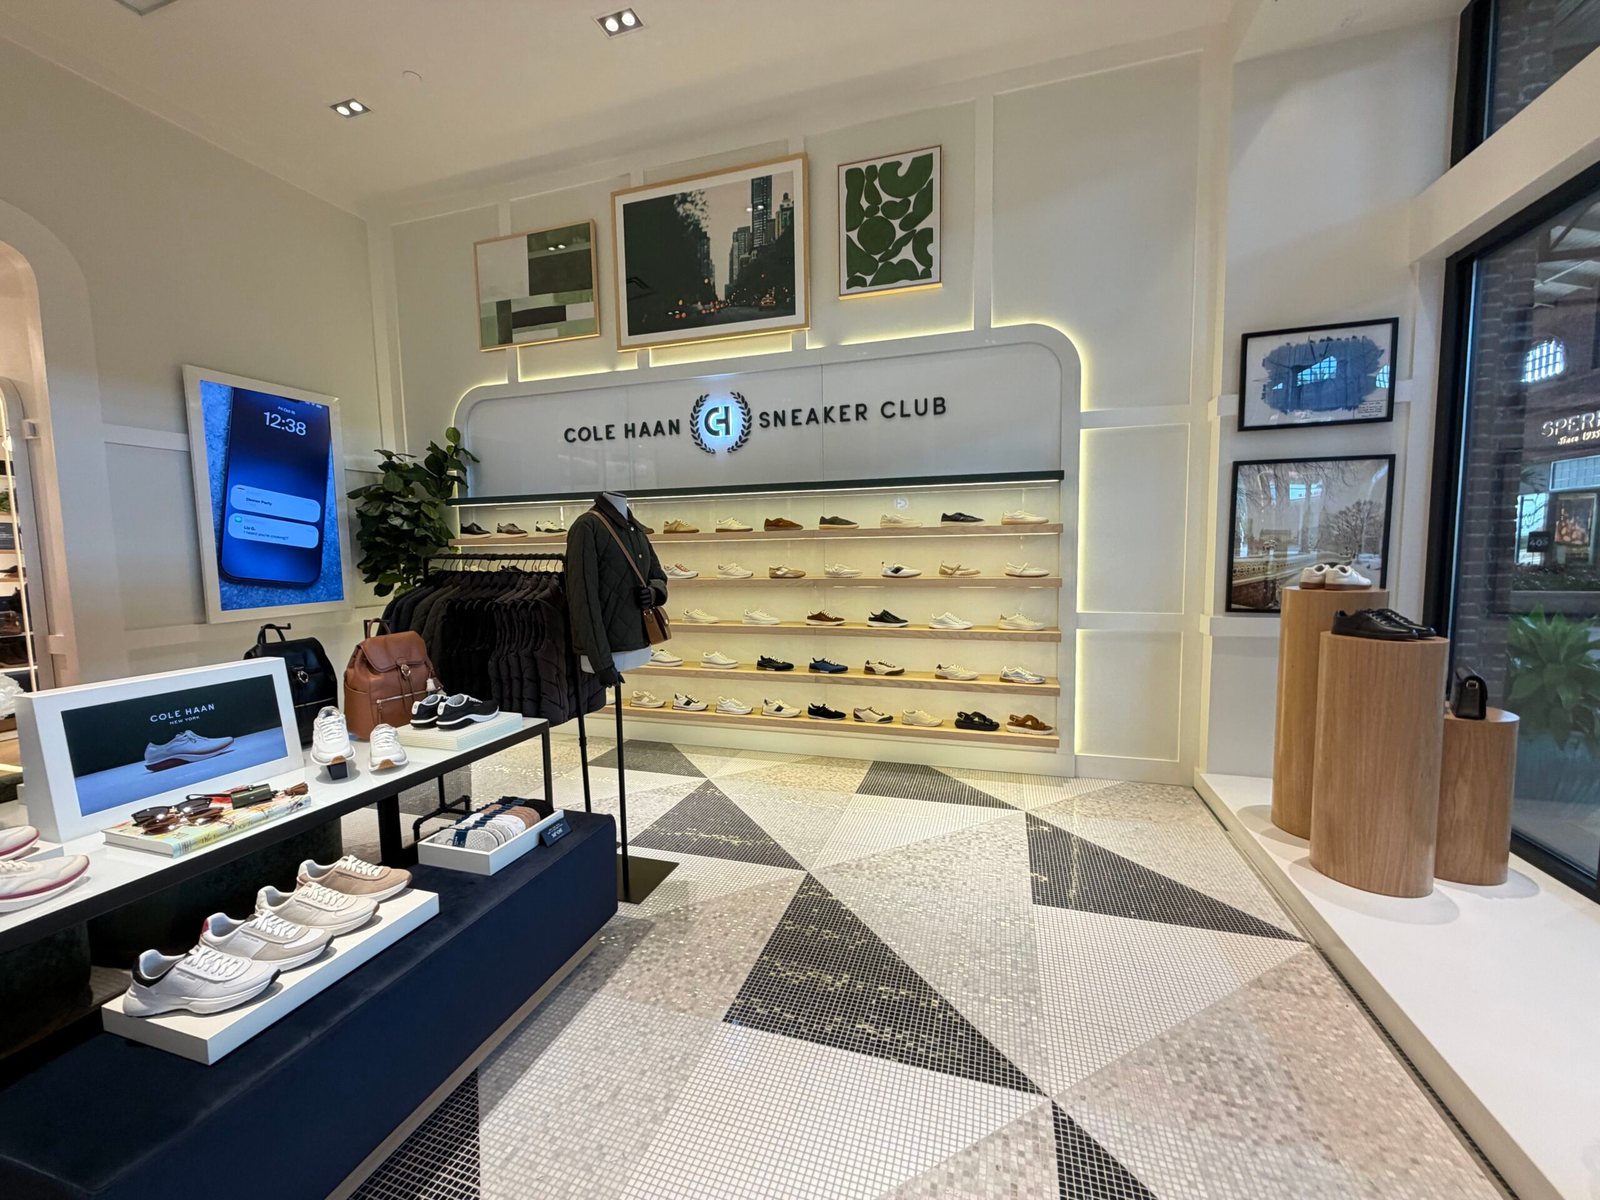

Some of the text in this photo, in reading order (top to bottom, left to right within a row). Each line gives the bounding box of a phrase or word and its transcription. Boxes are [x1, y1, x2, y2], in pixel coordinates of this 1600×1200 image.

[263, 411, 306, 436] 12:38
[564, 424, 616, 443] COLE
[624, 418, 680, 439] HAAN
[759, 403, 868, 428] SNEAKER
[880, 396, 947, 419] CLUB
[1541, 410, 1600, 437] SPER
[150, 703, 215, 722] COLE HAAN
